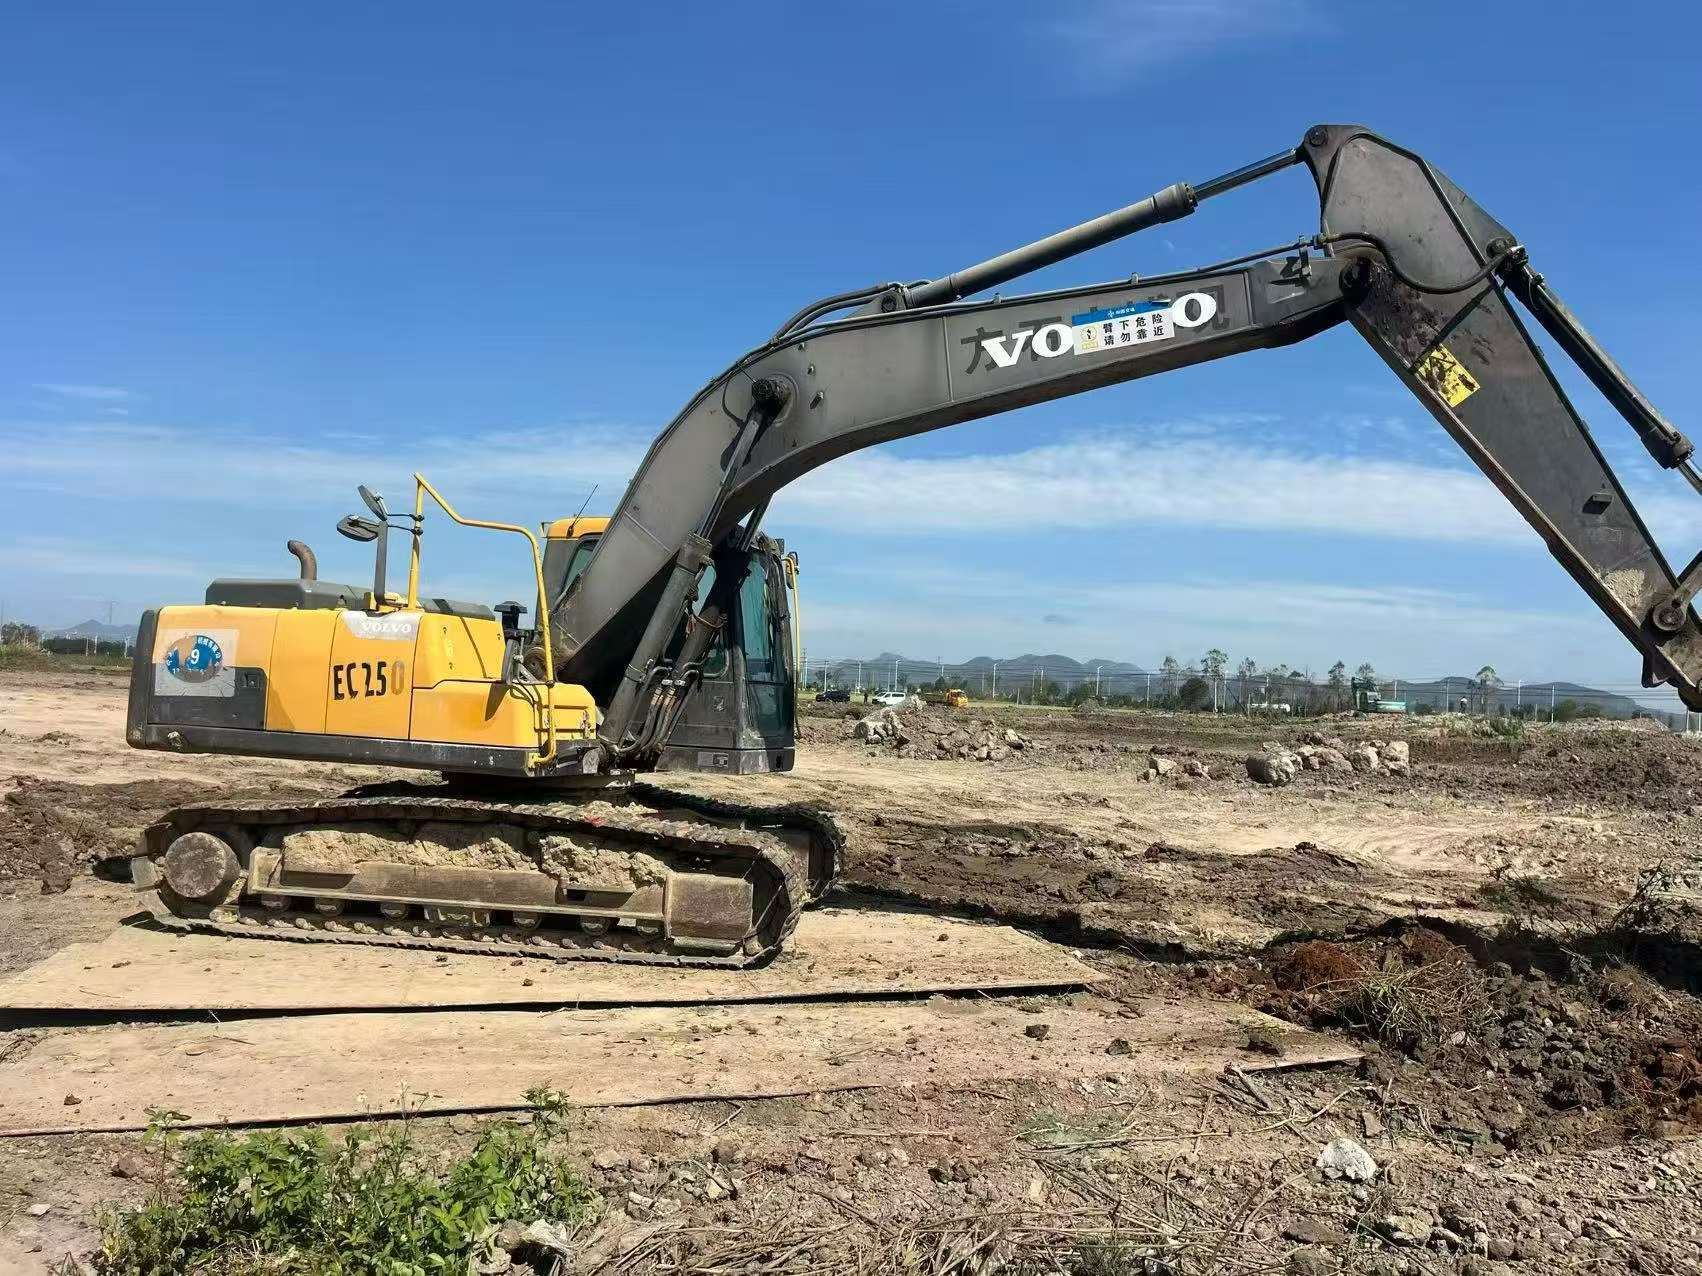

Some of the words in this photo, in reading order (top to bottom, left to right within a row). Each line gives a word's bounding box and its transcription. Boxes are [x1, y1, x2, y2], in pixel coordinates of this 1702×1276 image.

[981, 292, 1217, 368] VOO
[1103, 313, 1163, 333] 臂下危险
[1104, 326, 1165, 346] 请勿靠近
[333, 660, 405, 700] EC250
